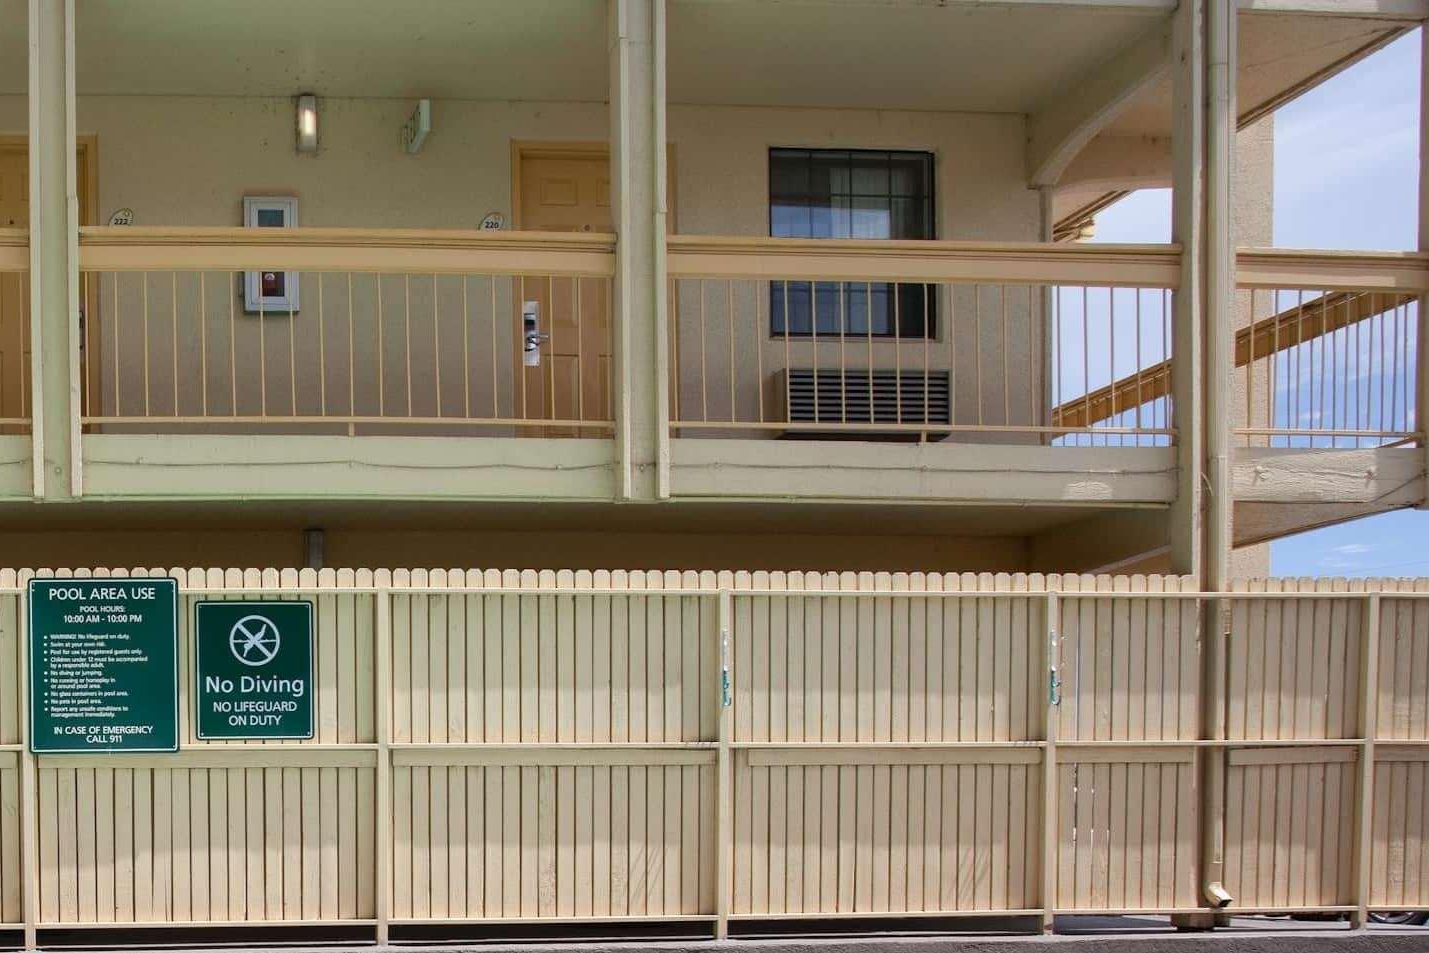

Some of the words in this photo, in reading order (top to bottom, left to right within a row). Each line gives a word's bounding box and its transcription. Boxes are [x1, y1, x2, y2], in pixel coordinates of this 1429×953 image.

[49, 588, 86, 600] POOL
[90, 588, 127, 600] AREA
[131, 588, 155, 599] USE
[64, 615, 84, 623] 10:00
[206, 676, 233, 693] No
[241, 675, 304, 697] Diving
[213, 702, 231, 712] NO
[234, 701, 297, 712] LIFEGUARD
[229, 716, 246, 726] ON
[250, 715, 282, 725] DUTY
[103, 726, 153, 734] EMERGENCY
[86, 735, 107, 743] CALL
[110, 735, 122, 743] 911
